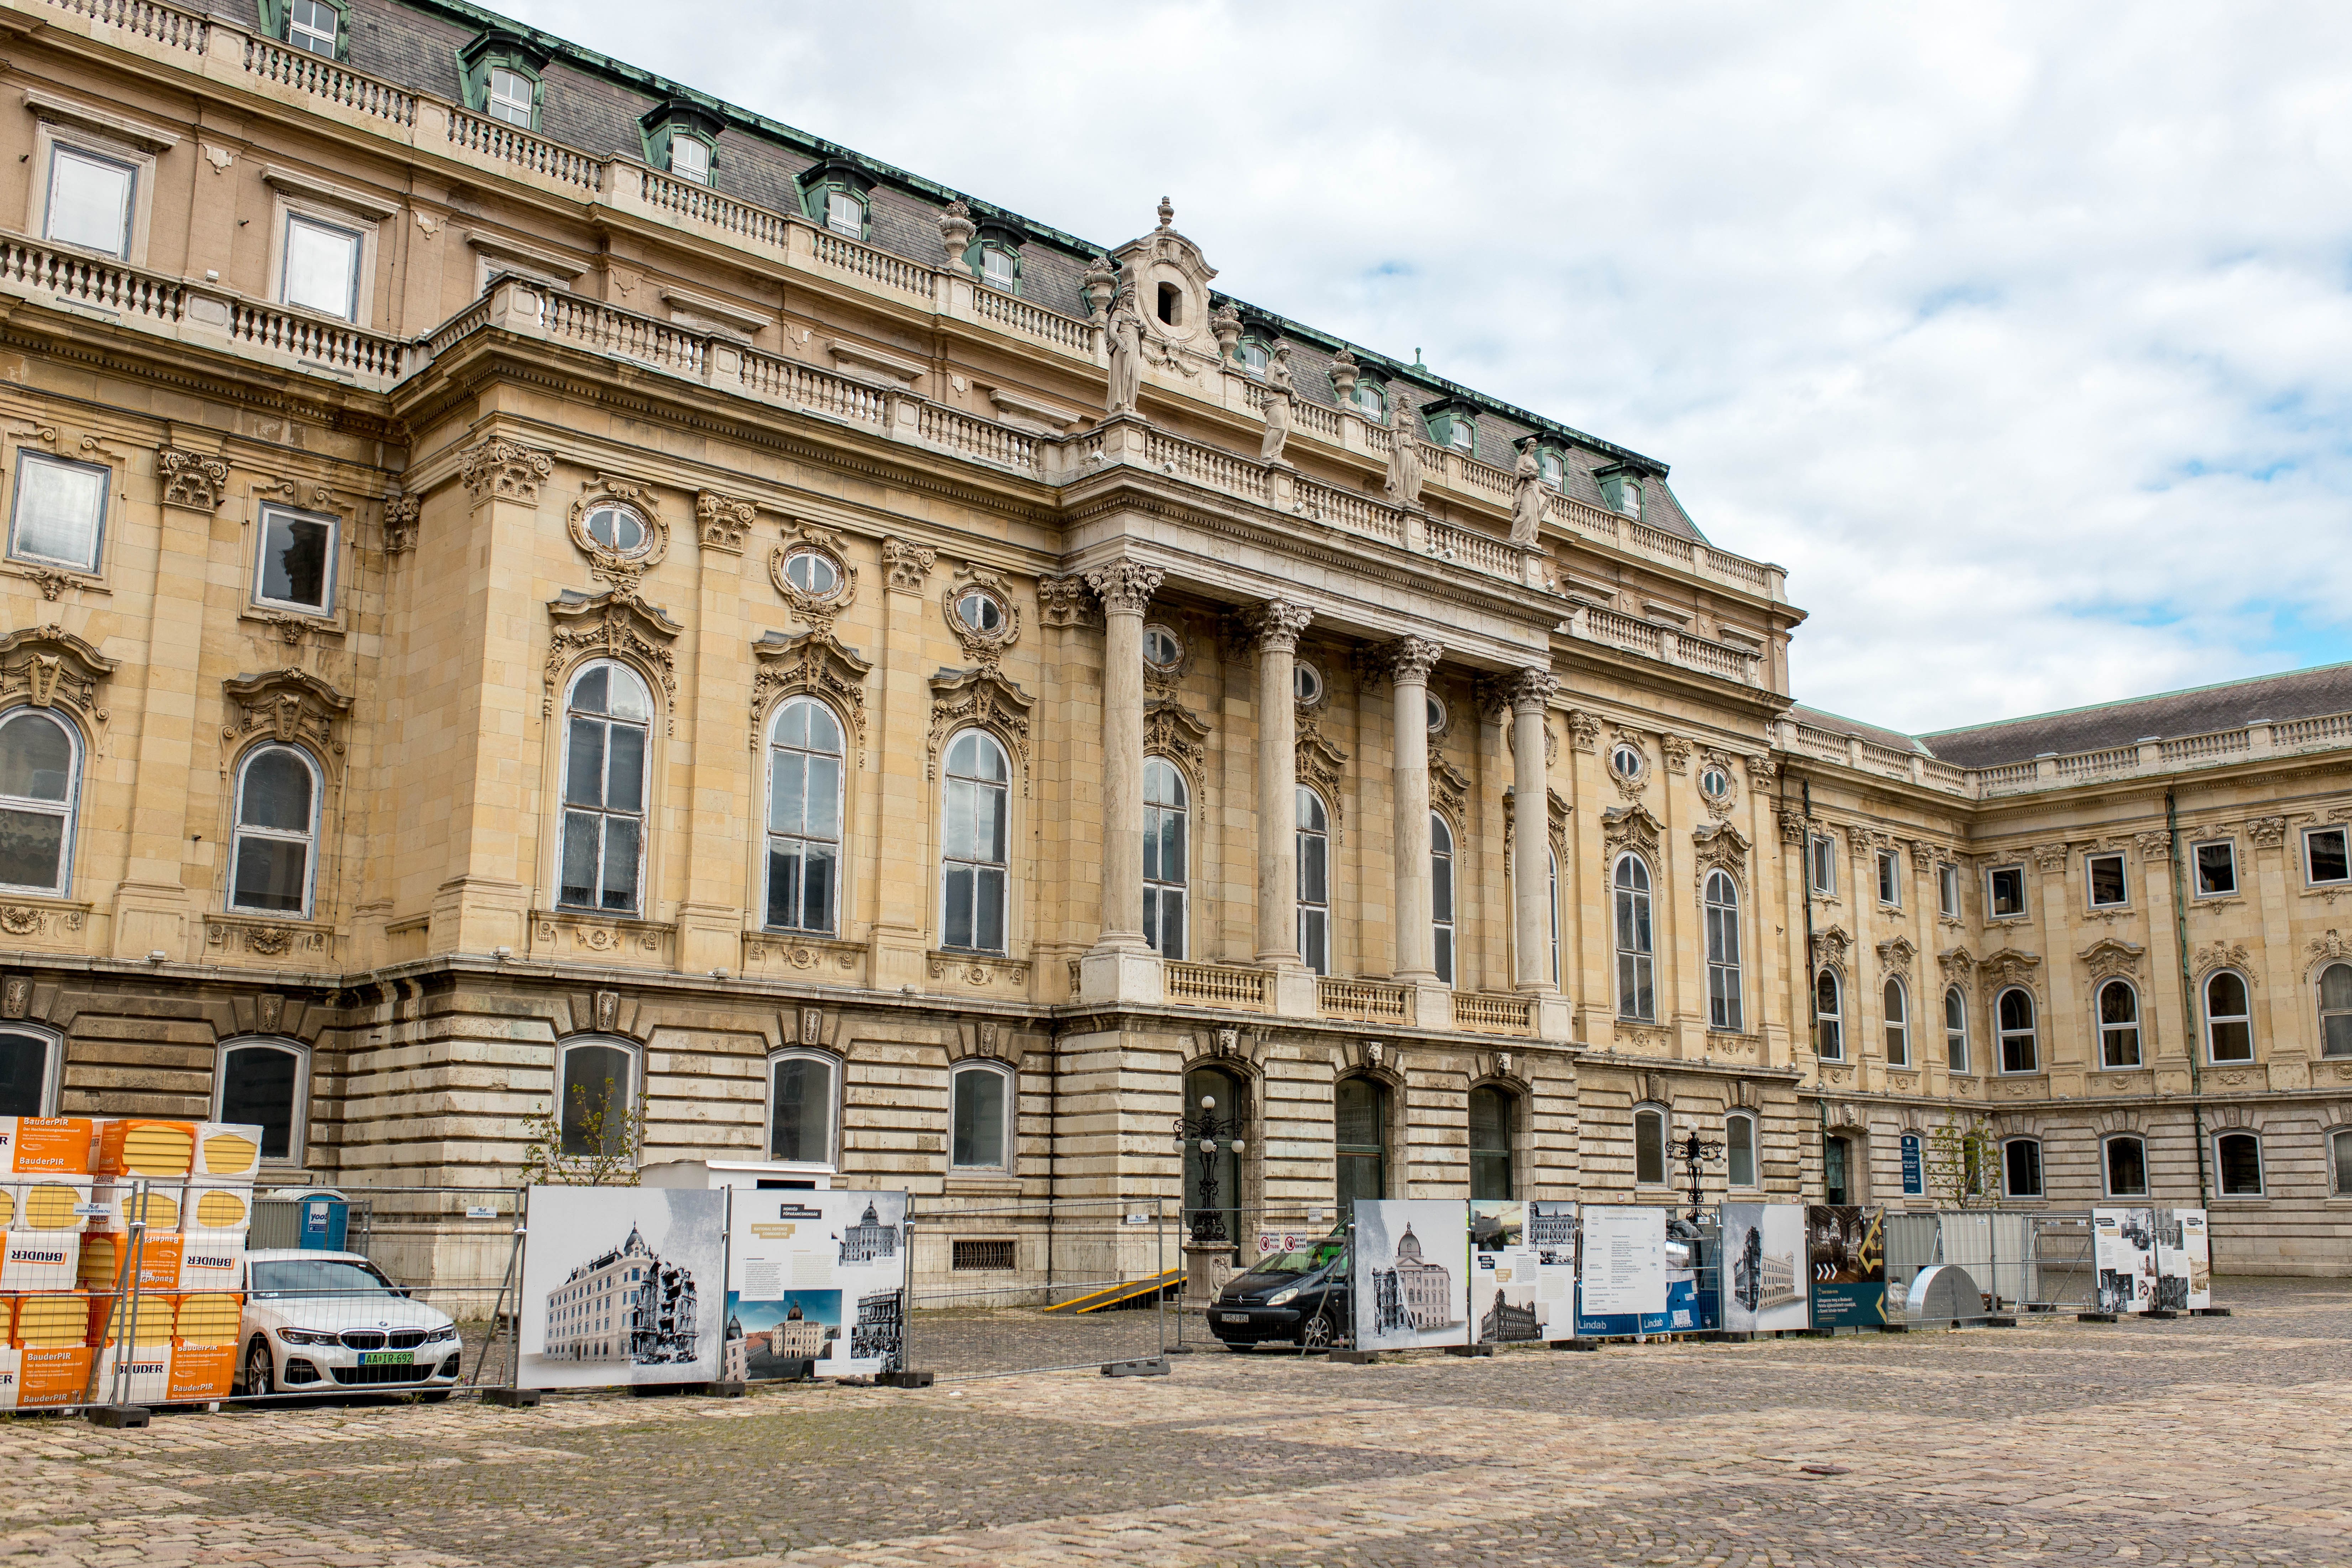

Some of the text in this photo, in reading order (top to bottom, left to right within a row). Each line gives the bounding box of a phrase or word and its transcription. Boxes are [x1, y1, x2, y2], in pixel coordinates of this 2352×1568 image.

[24, 1117, 68, 1126] BauderPIR
[20, 1157, 64, 1166] BauderPIR
[11, 1250, 63, 1261] BAUDER
[188, 1256, 232, 1266] BAUDER
[1578, 1320, 1607, 1329] Lindab
[1644, 1318, 1663, 1328] Lindab
[28, 1353, 71, 1361] BauderPIR
[366, 1354, 412, 1364] AA IR-692
[119, 1365, 163, 1374] BUDER
[173, 1383, 213, 1392] BauderPIR
[24, 1394, 68, 1403] BauderPIR
